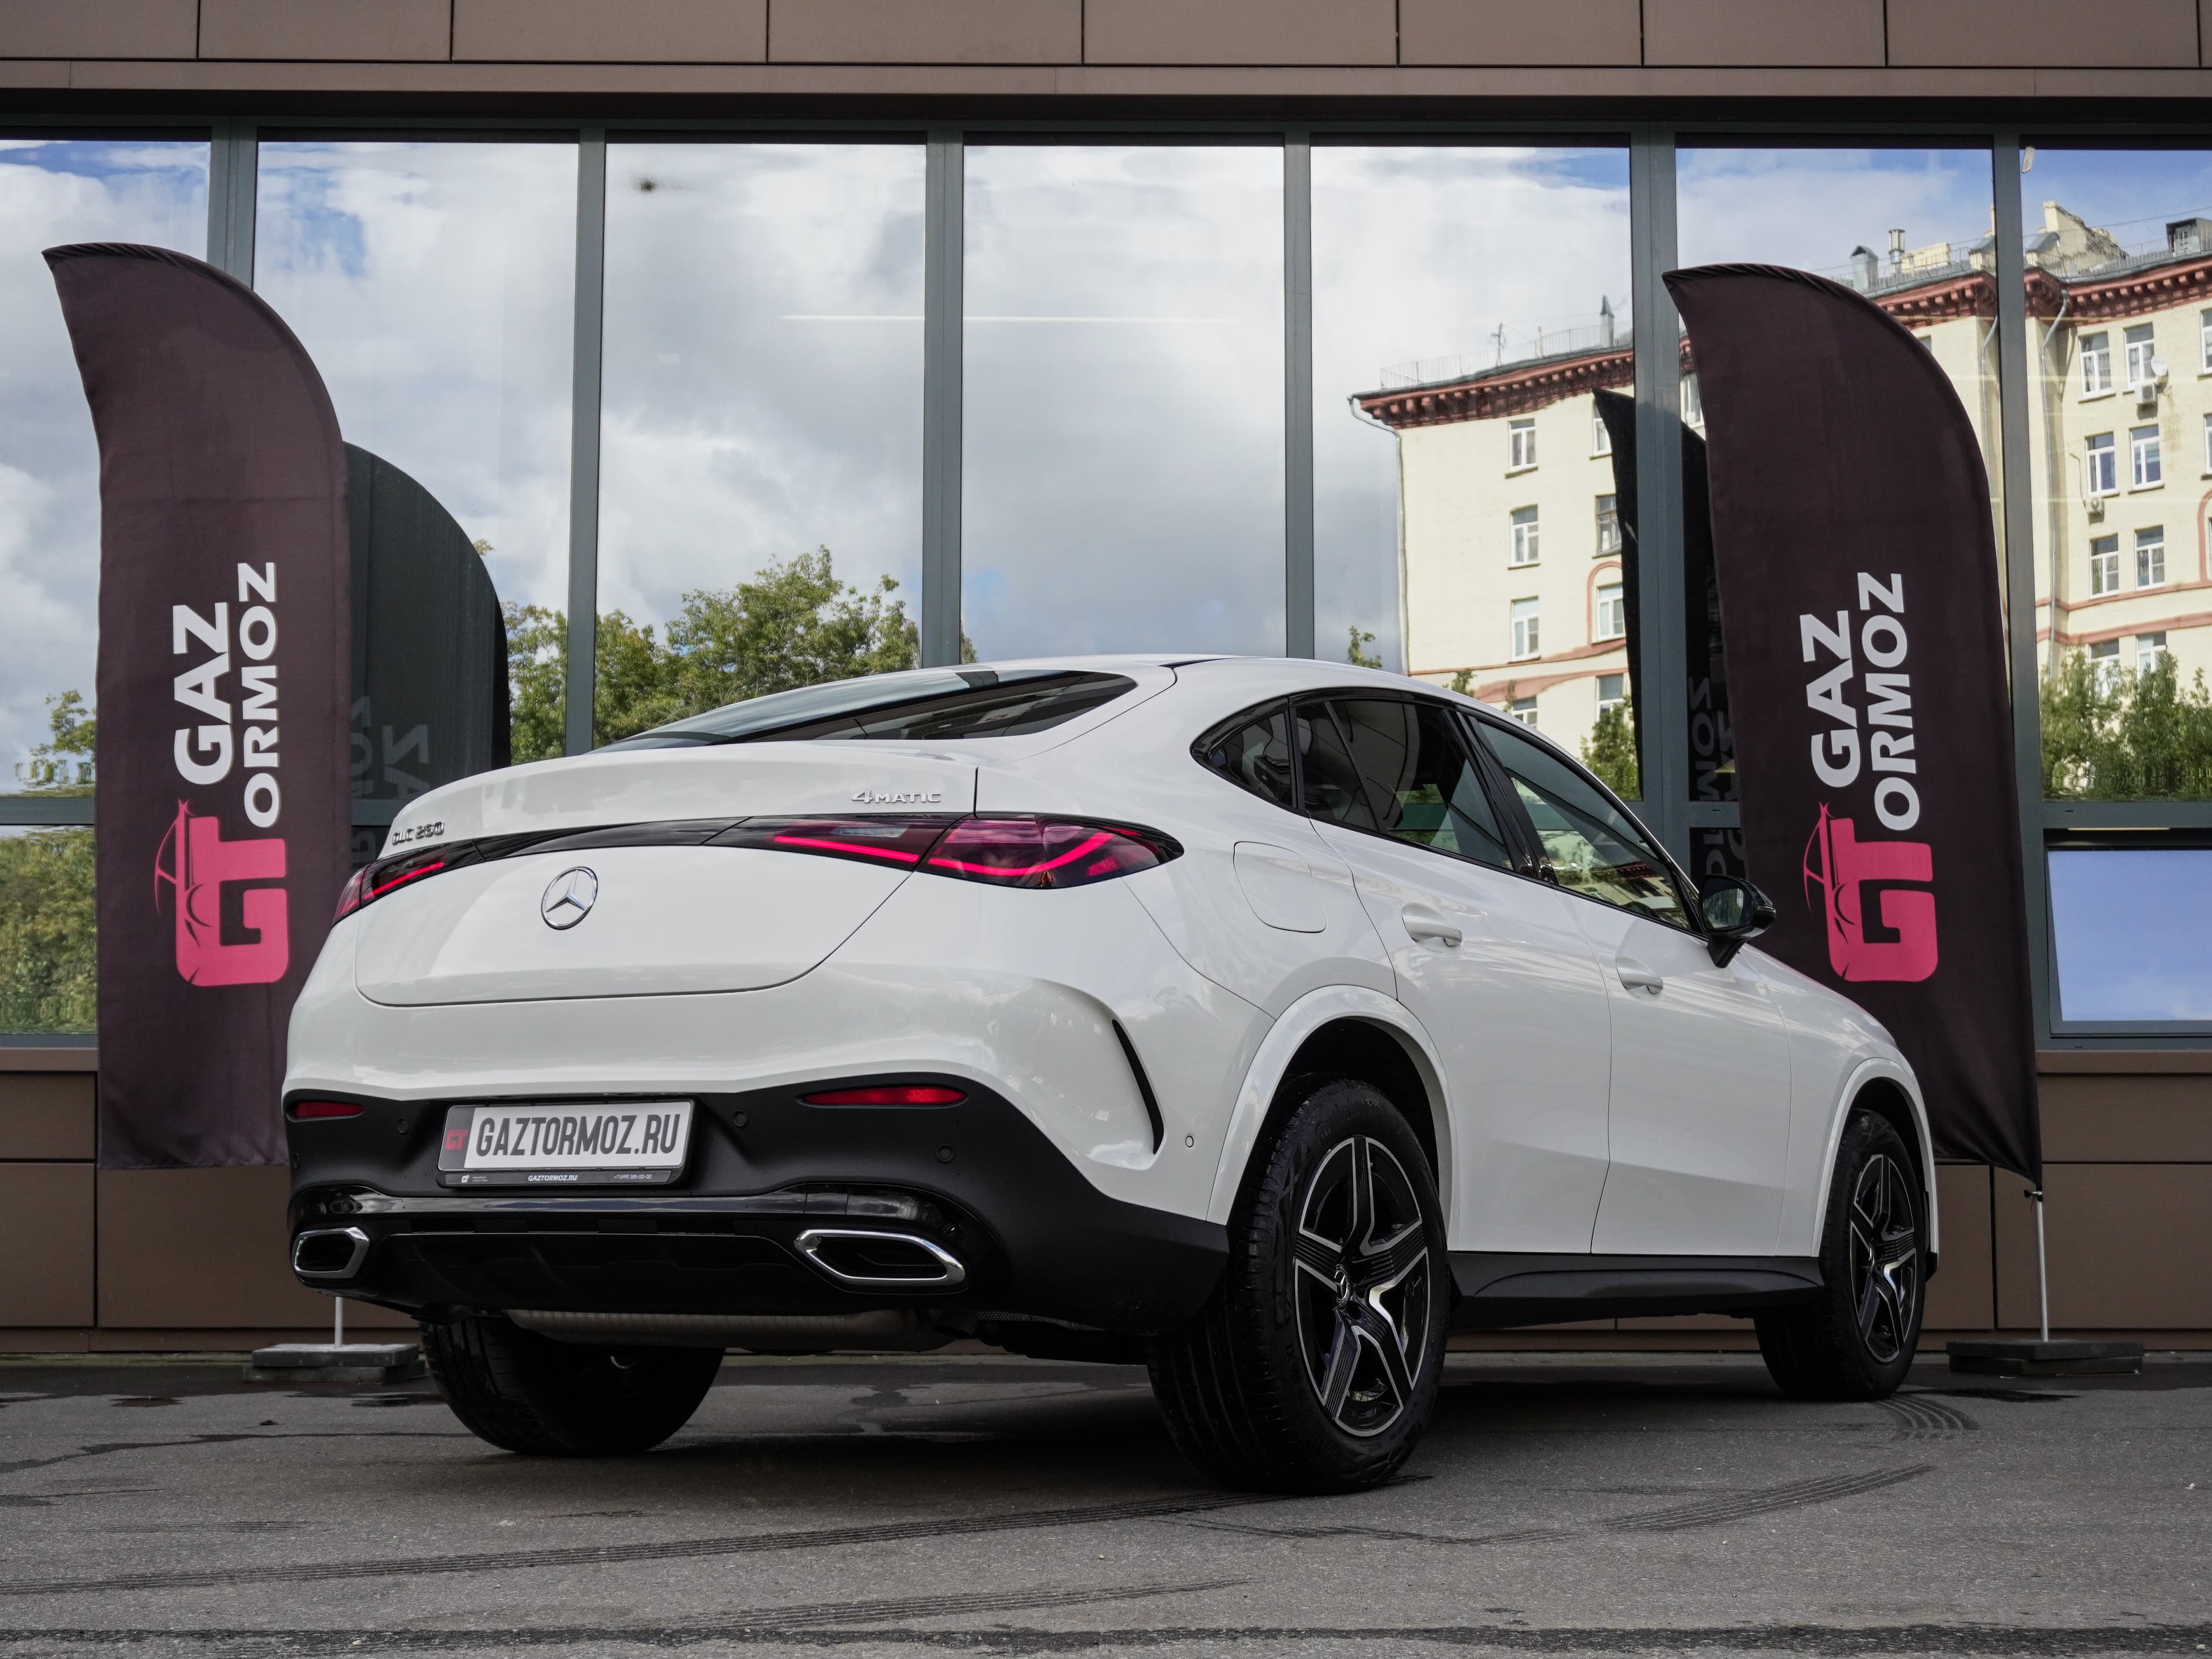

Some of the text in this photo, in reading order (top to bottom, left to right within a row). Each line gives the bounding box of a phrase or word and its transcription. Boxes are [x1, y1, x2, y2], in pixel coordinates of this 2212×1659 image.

[173, 602, 232, 785] GAZ
[238, 562, 280, 828] ORMOZ
[1800, 610, 1861, 788] GAZ
[1857, 572, 1920, 831] ORMOZ
[392, 828, 414, 845] GLC
[851, 790, 941, 803] 4MATIC
[476, 1114, 681, 1157] GAZTORMOZ.RU
